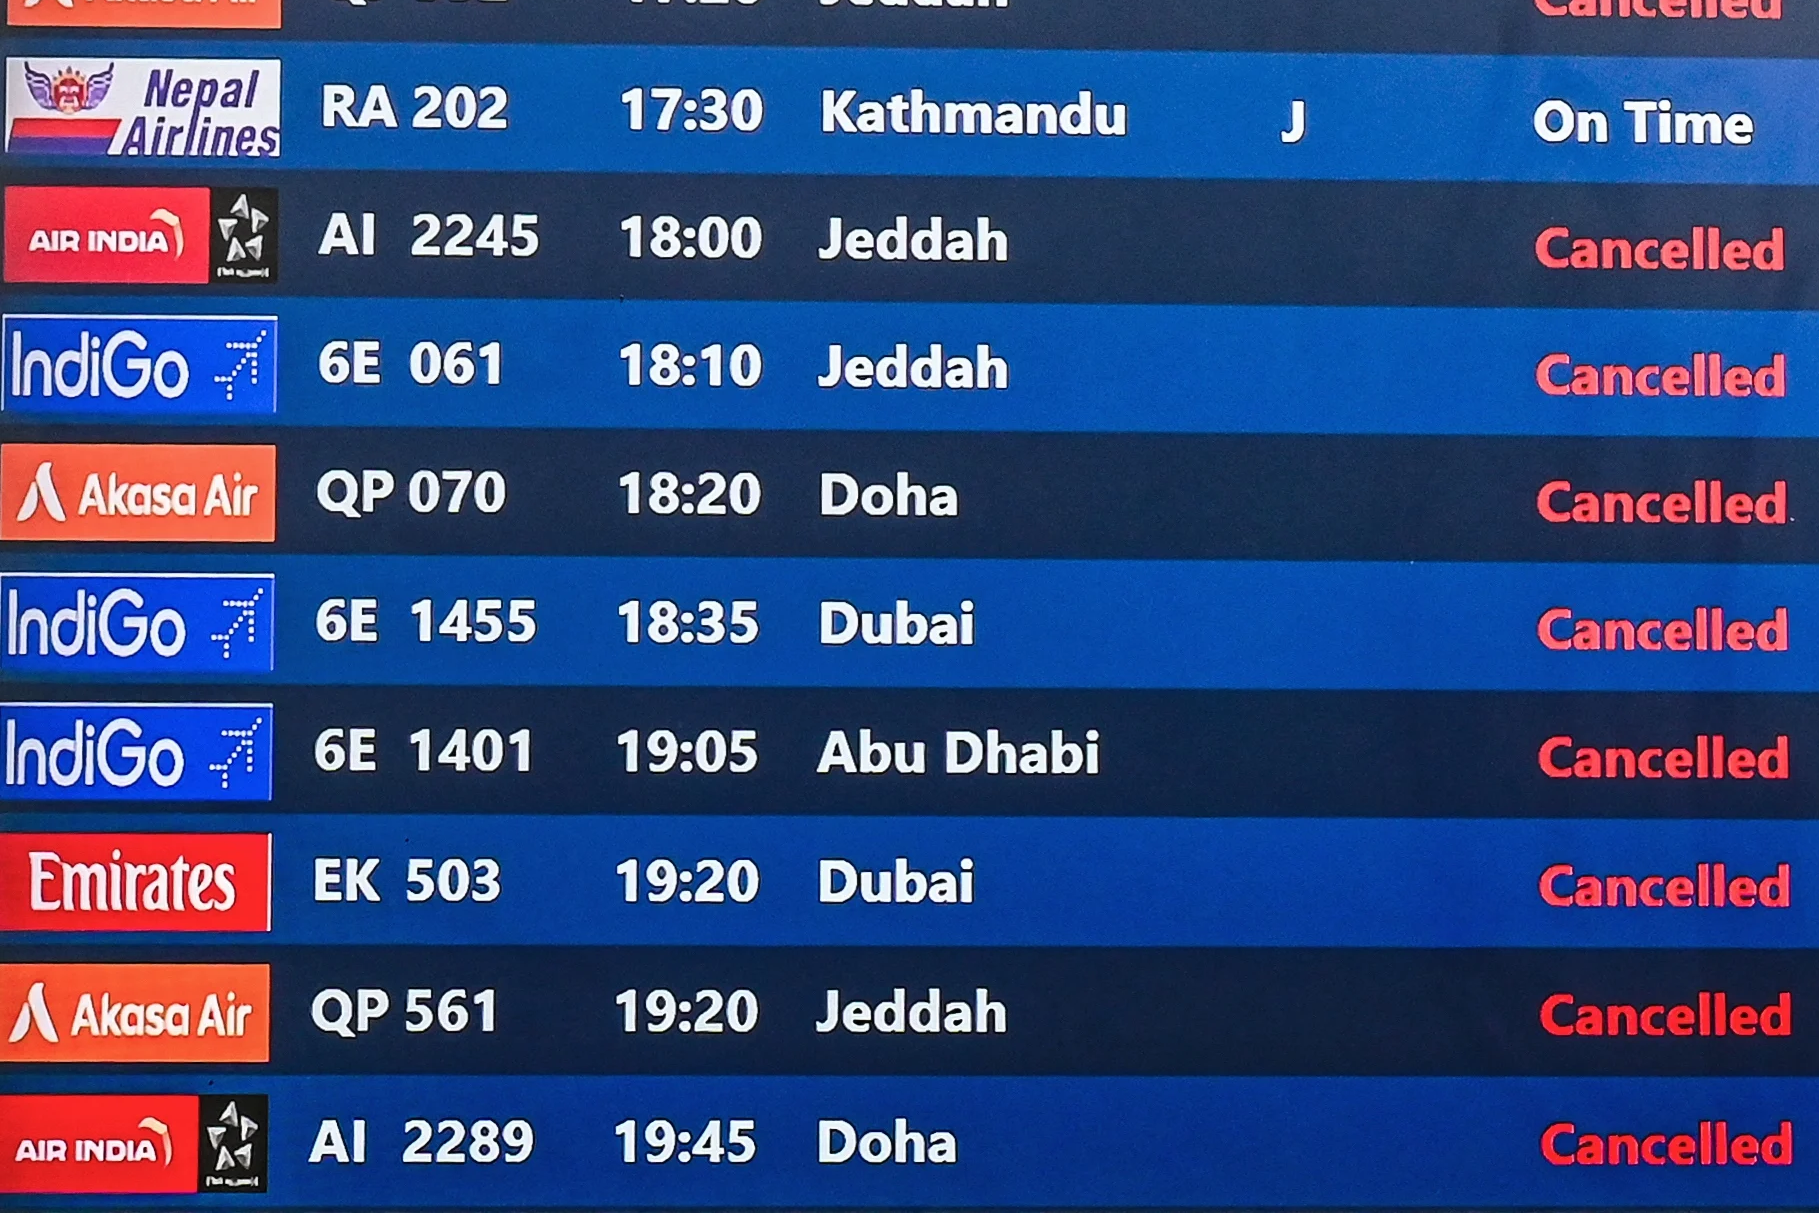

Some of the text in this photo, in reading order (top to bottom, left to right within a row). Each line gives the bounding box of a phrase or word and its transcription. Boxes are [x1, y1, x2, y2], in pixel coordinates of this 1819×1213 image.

[142, 68, 261, 110] Nepal
[322, 85, 1754, 145] RA 202 17:30 Kathmandu J On Time
[120, 115, 282, 157] Airlines
[29, 230, 169, 252] AIR INDIA
[318, 212, 1786, 271] AI 2245 18:00 Jeddah Cancelled
[11, 329, 190, 399] IndiGo
[318, 340, 1786, 397] 6E 061 18:10 Jeddah Cancelled
[78, 472, 259, 516] Akasa Air
[316, 469, 1788, 525] QP 070 18:20 Doha Cancelled
[8, 588, 186, 658] IndiGo
[315, 598, 1788, 651] 6E 1455 18:35 Dubai Cancelled
[5, 717, 185, 787] IndiGo
[314, 727, 1791, 780] 6E 1401 19:05 Abu Dhabi Cancelled
[28, 849, 236, 912] Emirates
[314, 857, 1791, 908] EK 503 19:20 Dubai Cancelled
[71, 991, 252, 1036] Akasa Air
[310, 987, 1793, 1038] QP 561 19:20 Jeddah Cancelled
[15, 1139, 157, 1162] AIR INDIA
[307, 1117, 1794, 1166] AI 2289 19:45 Doha Cancelled
